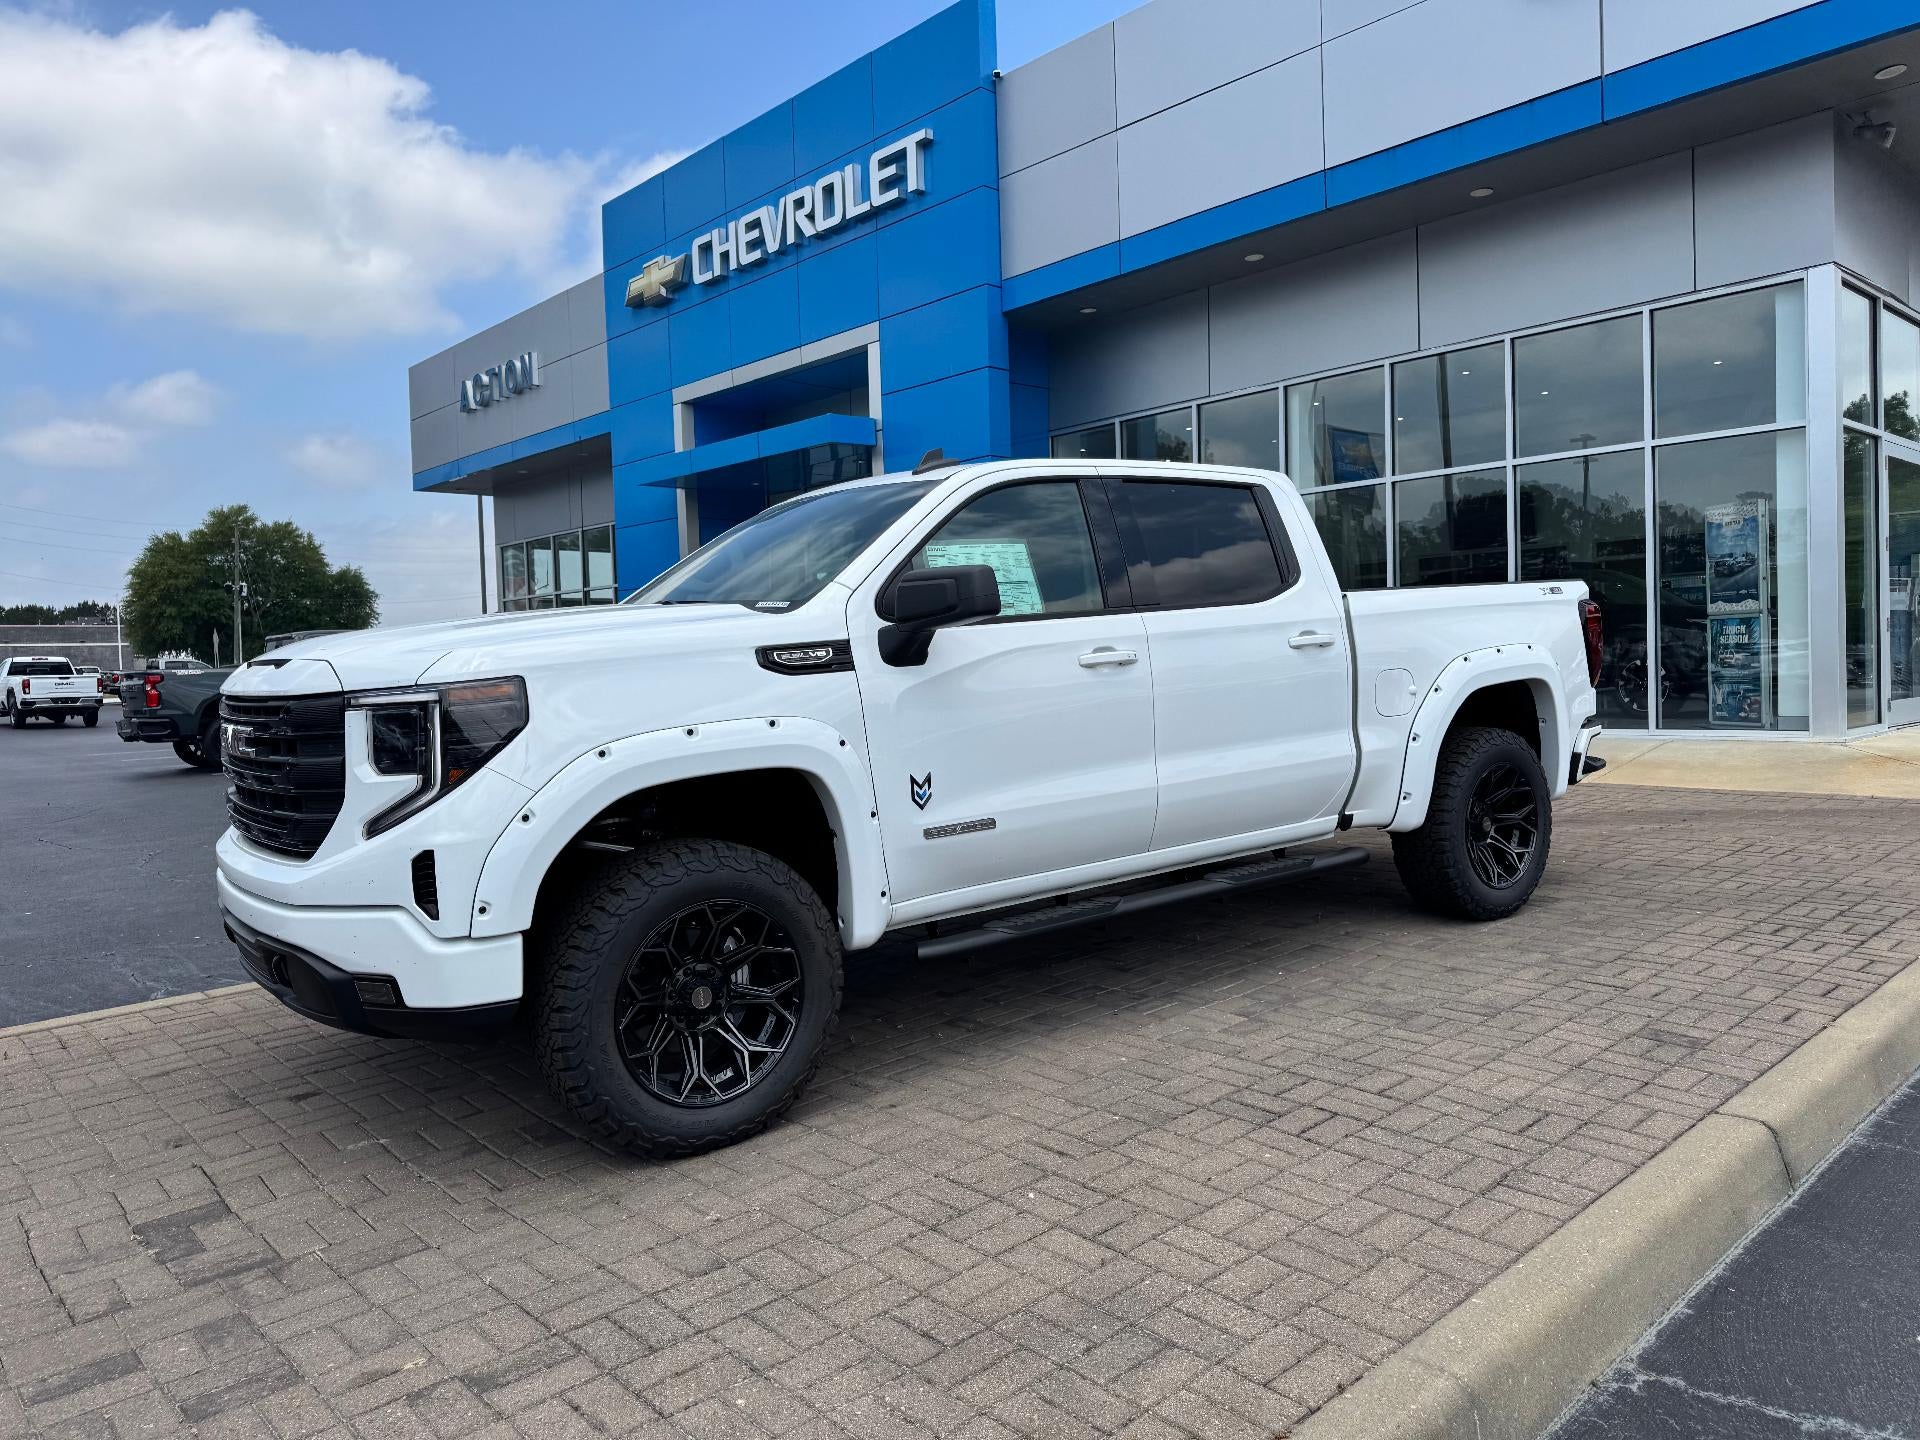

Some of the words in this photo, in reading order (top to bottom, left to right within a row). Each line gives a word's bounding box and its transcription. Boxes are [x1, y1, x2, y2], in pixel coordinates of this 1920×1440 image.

[692, 128, 934, 285] CHEVROLET
[460, 352, 540, 413] ACTION
[1719, 634, 1749, 644] SEASON
